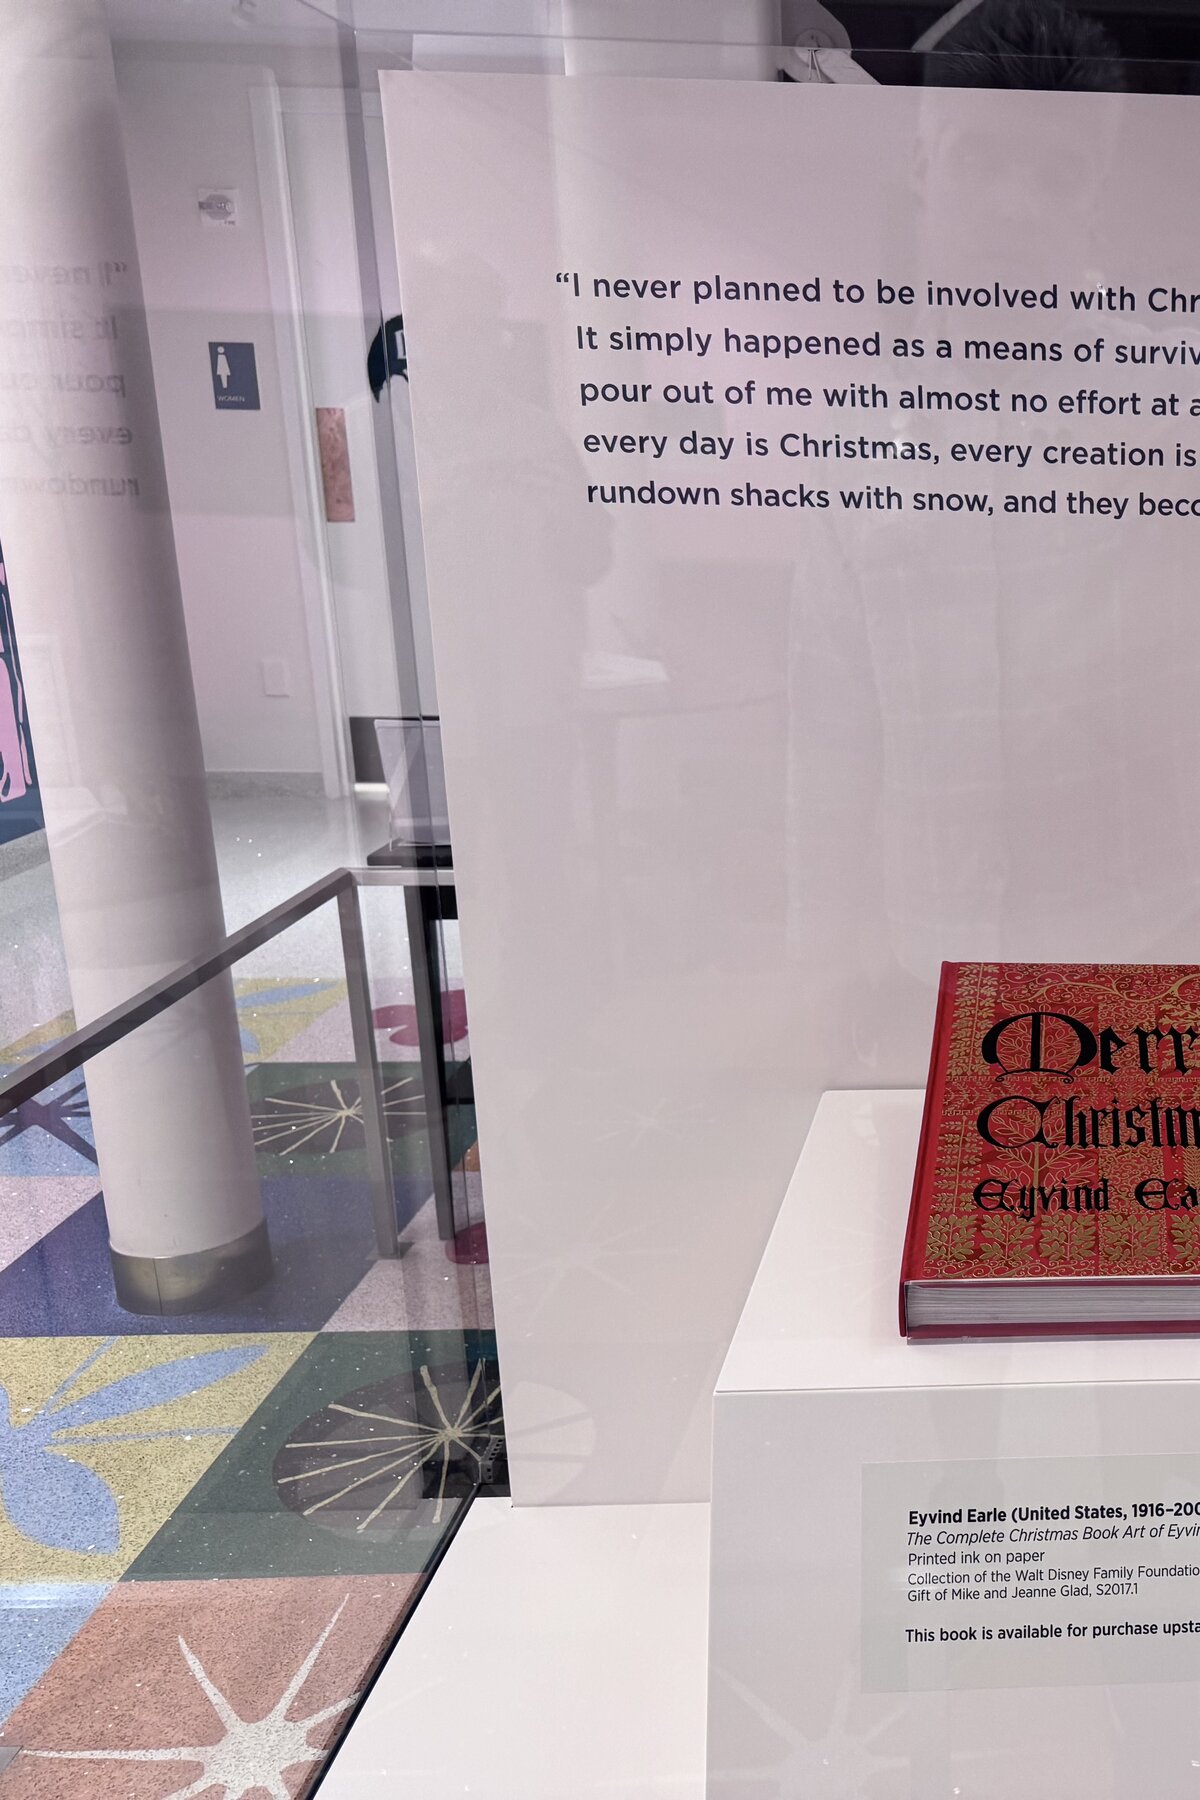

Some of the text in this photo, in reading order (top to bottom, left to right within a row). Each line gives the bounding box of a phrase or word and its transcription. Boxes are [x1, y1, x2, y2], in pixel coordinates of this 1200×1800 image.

[593, 278, 682, 299] never
[693, 274, 821, 305] planned
[832, 279, 865, 304] to
[877, 278, 916, 306] be
[927, 280, 1058, 310] involved
[1069, 285, 1136, 312] with
[576, 325, 599, 350] It
[609, 325, 713, 357] simply
[724, 327, 881, 359] happened
[892, 338, 925, 358] as
[935, 339, 953, 359] a
[964, 340, 1063, 362] means
[1073, 337, 1105, 363] of
[580, 383, 653, 407] pour
[662, 380, 714, 404] out
[724, 380, 756, 405] of
[766, 386, 813, 407] me
[822, 382, 888, 409] with
[898, 384, 1001, 412] almost
[1011, 393, 1048, 413] no
[1058, 389, 1142, 416] effort
[1151, 393, 1180, 417] at
[583, 434, 668, 459] every
[679, 430, 735, 460] day
[746, 431, 769, 457] is
[779, 432, 940, 465] Christmas,
[950, 443, 1033, 468] every
[1042, 441, 1164, 467] creation
[1175, 442, 1197, 468] is
[587, 480, 720, 506] rundown
[730, 482, 830, 509] shacks
[839, 485, 903, 510] with
[912, 492, 994, 517] snow,
[1003, 489, 1057, 514] and
[1066, 490, 1130, 520] they
[973, 1178, 1109, 1222] Eyvind
[908, 1508, 963, 1528] Eyvind
[967, 1507, 1007, 1523] Earle
[1011, 1505, 1071, 1524] (United
[1074, 1504, 1128, 1521] States,
[907, 1531, 933, 1546] The
[936, 1529, 1005, 1547] Complete
[1009, 1527, 1079, 1543] Christmas
[1082, 1524, 1120, 1540] Book
[1121, 1524, 1146, 1539] Art
[1148, 1522, 1165, 1539] of
[908, 1550, 1046, 1567] Printed ink on paper
[907, 1571, 970, 1586] Collection
[973, 1569, 988, 1583] of
[990, 1569, 1012, 1583] the
[1014, 1568, 1045, 1582] Walt
[1048, 1567, 1090, 1585] Disney
[1093, 1565, 1134, 1583] Family
[907, 1581, 1138, 1602] Gift of Mike and Jeanne Glad, S2017.1
[904, 1628, 936, 1643] This
[939, 1626, 978, 1642] book
[981, 1625, 994, 1641] is
[997, 1623, 1063, 1640] available
[1066, 1623, 1089, 1638] for
[1092, 1621, 1159, 1640] purchase
